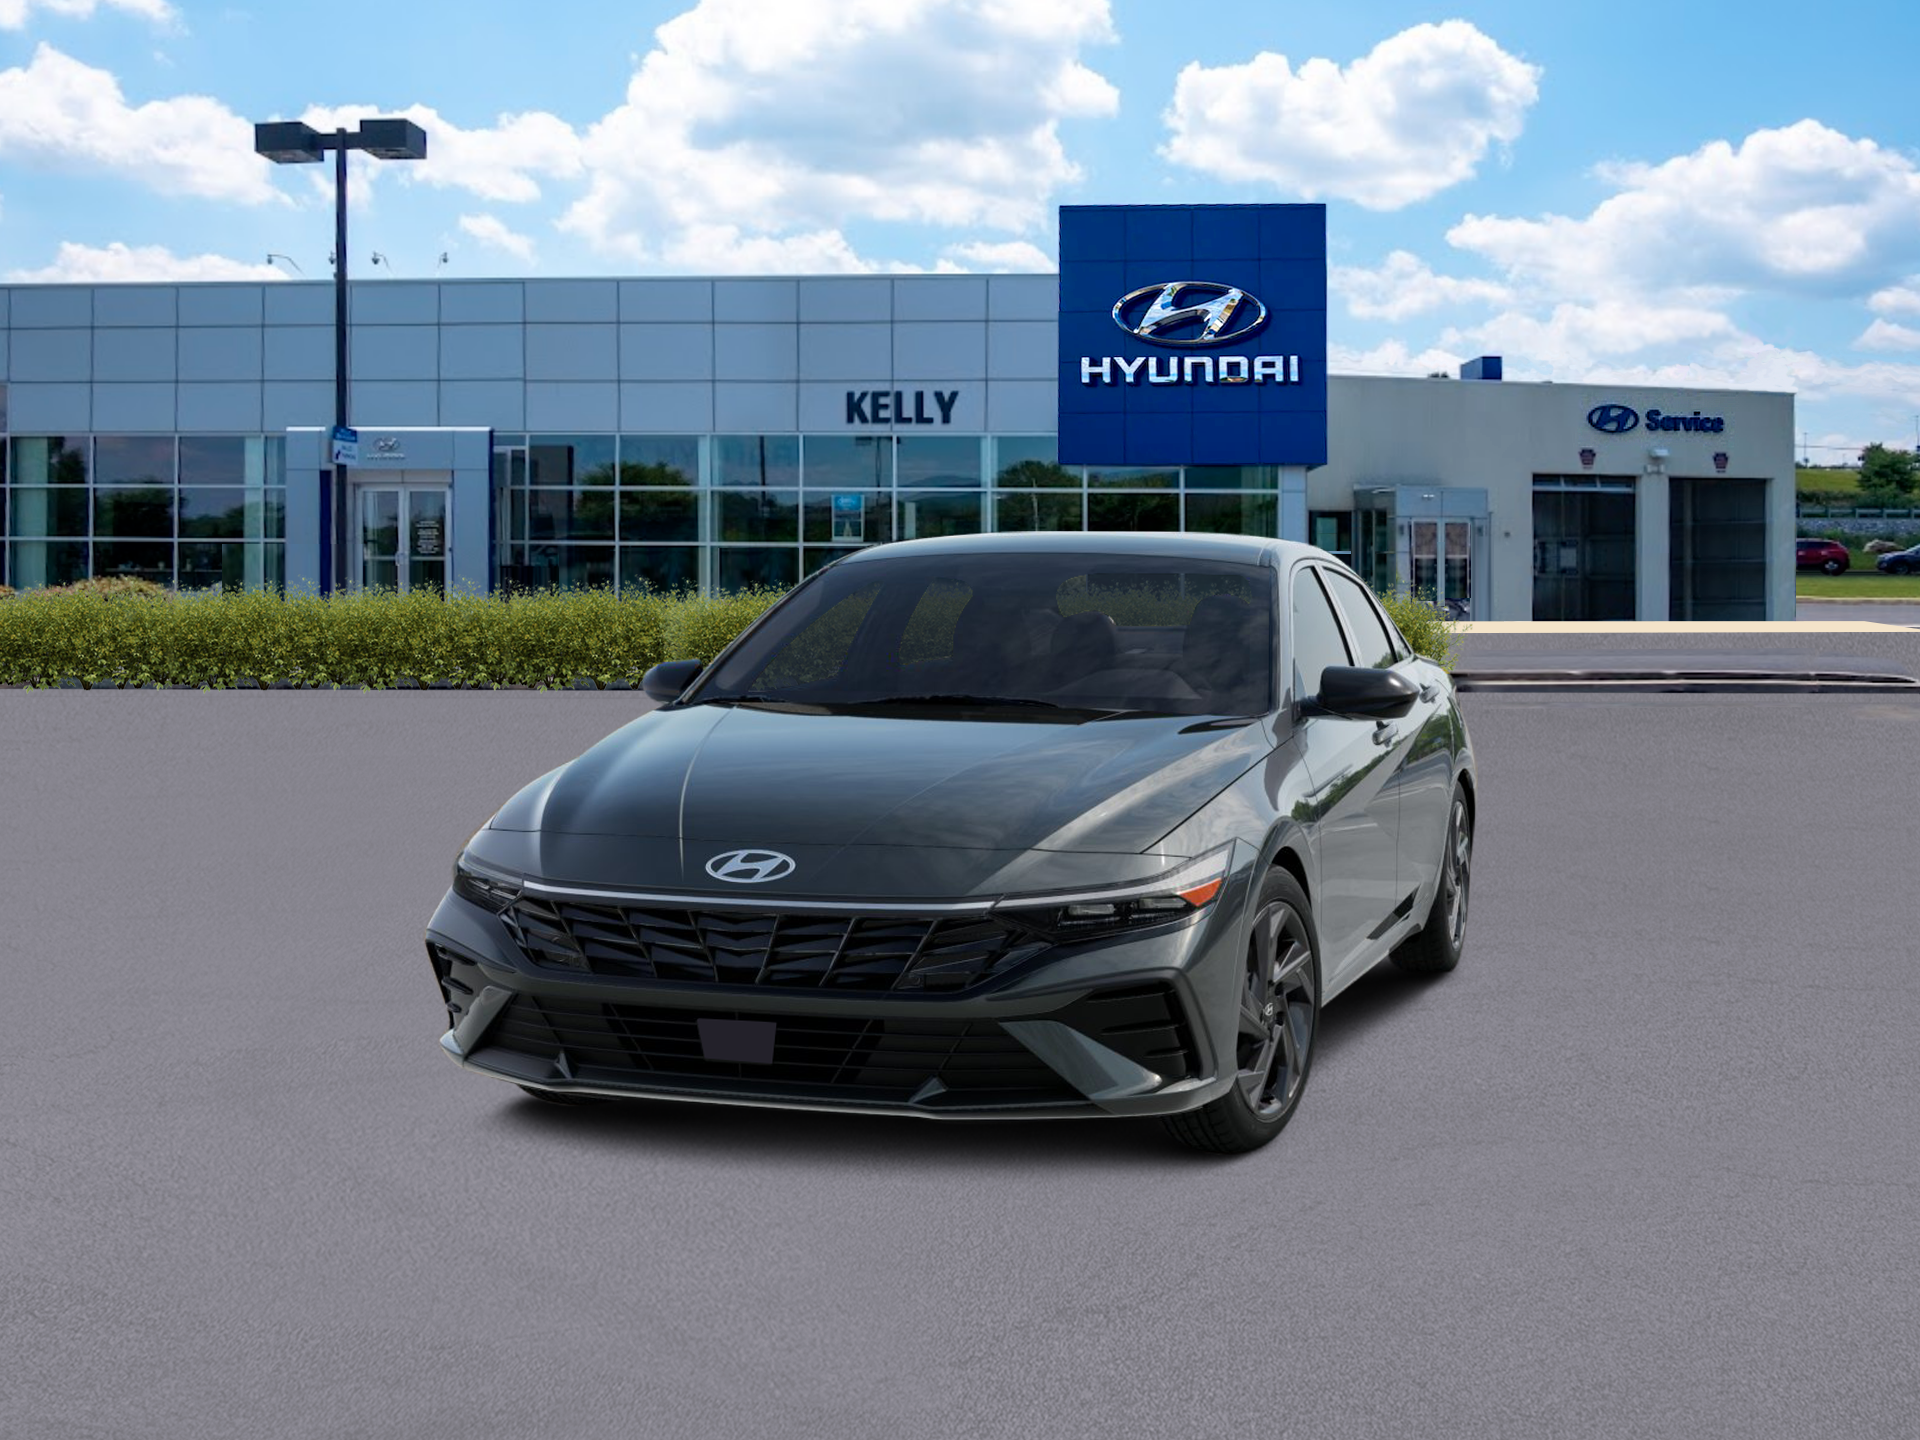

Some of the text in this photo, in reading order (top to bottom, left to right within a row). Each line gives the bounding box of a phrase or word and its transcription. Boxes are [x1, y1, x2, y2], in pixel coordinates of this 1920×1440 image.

[1080, 354, 1300, 385] HYUNDAI
[846, 390, 959, 424] KELLY
[1645, 409, 1724, 433] Service
